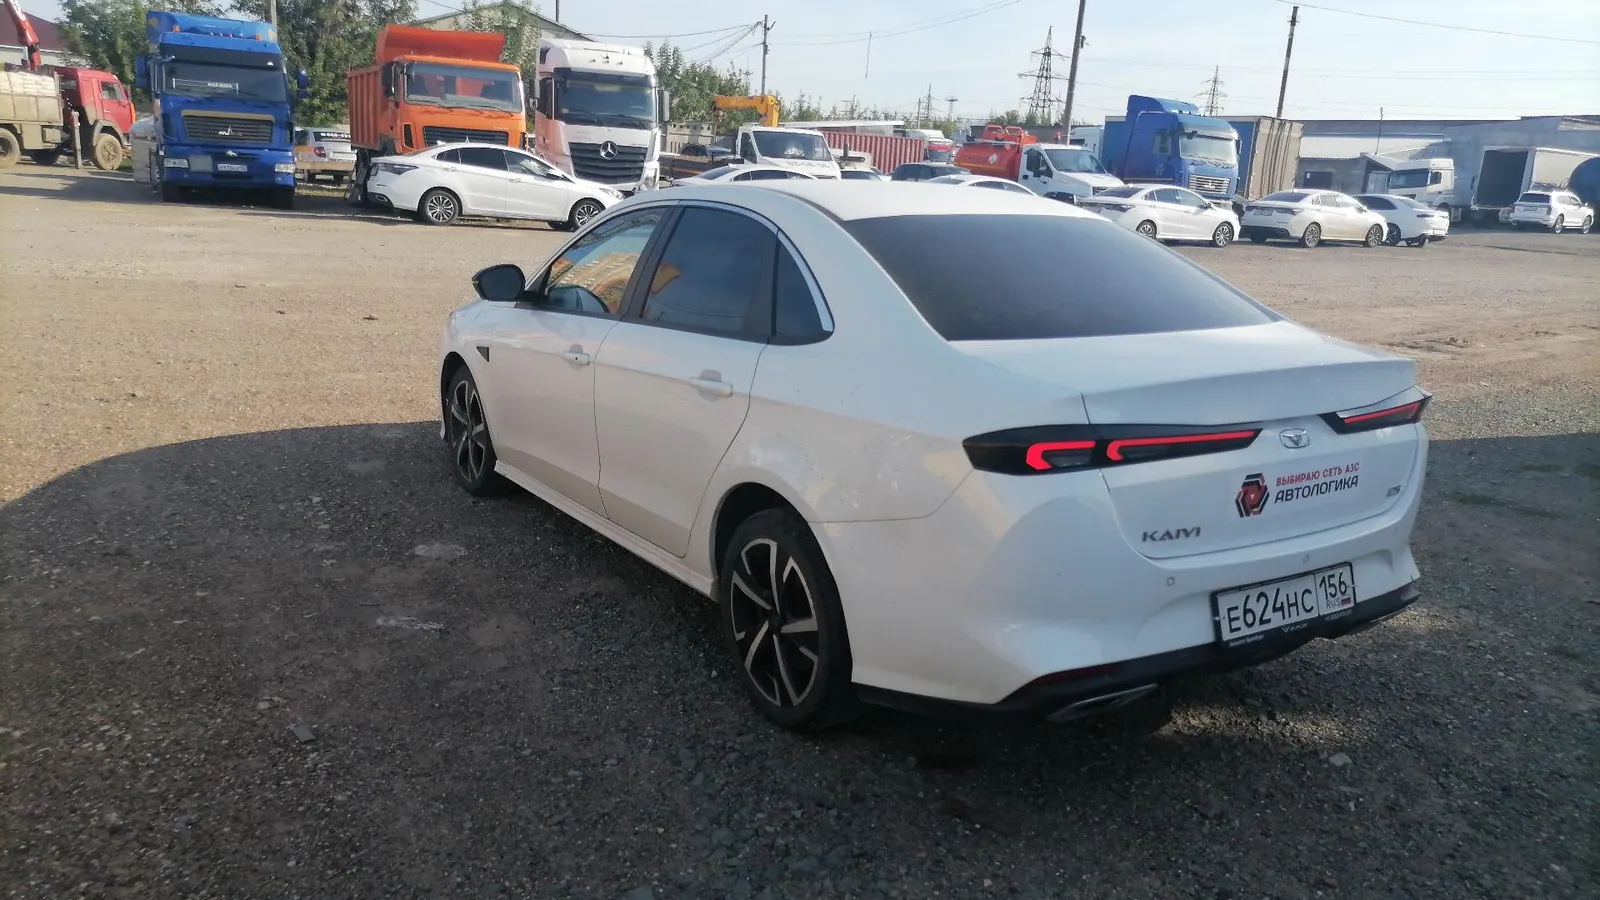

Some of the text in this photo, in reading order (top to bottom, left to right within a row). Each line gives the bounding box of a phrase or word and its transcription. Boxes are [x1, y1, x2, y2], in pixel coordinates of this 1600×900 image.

[1276, 462, 1360, 487] ВЫБИРАЮ СЕТЬ АЗС
[1274, 475, 1359, 504] АВТОЛОГИКА
[1319, 571, 1348, 600] 156
[1326, 598, 1341, 609] RUS
